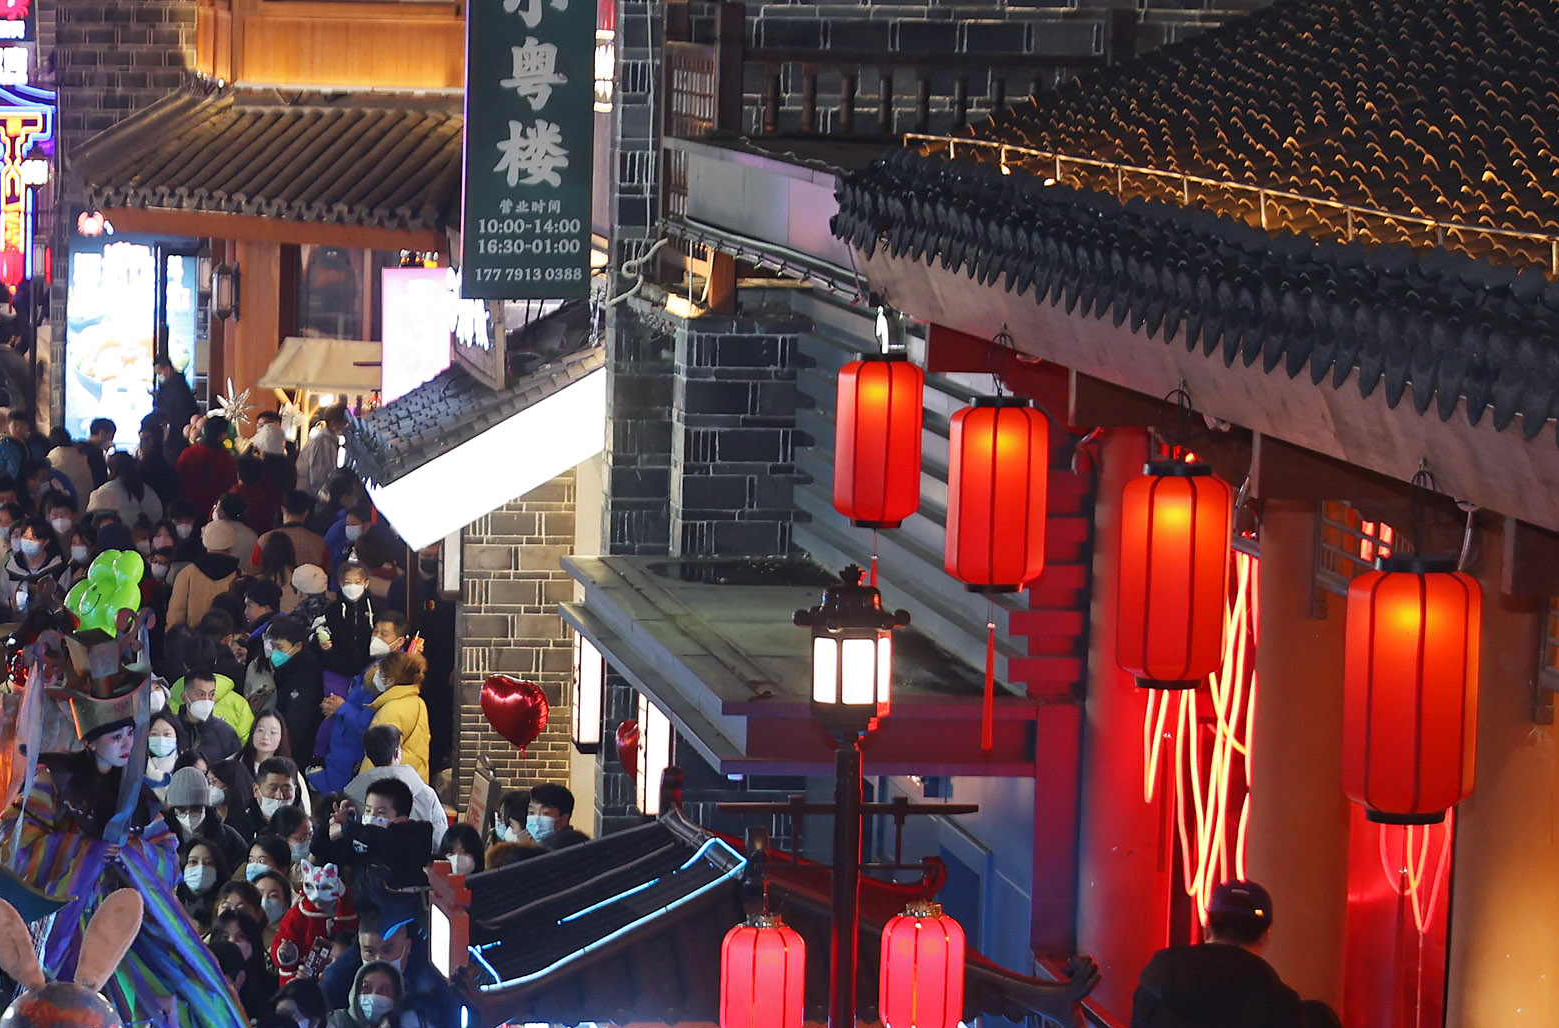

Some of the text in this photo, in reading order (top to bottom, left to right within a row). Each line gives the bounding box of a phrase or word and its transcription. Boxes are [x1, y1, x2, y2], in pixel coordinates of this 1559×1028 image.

[499, 198, 561, 214] 营业时间
[478, 218, 581, 233] 10:00-14:00
[478, 238, 581, 254] 16:30-01:00
[475, 267, 582, 281] 177 7913 0388
